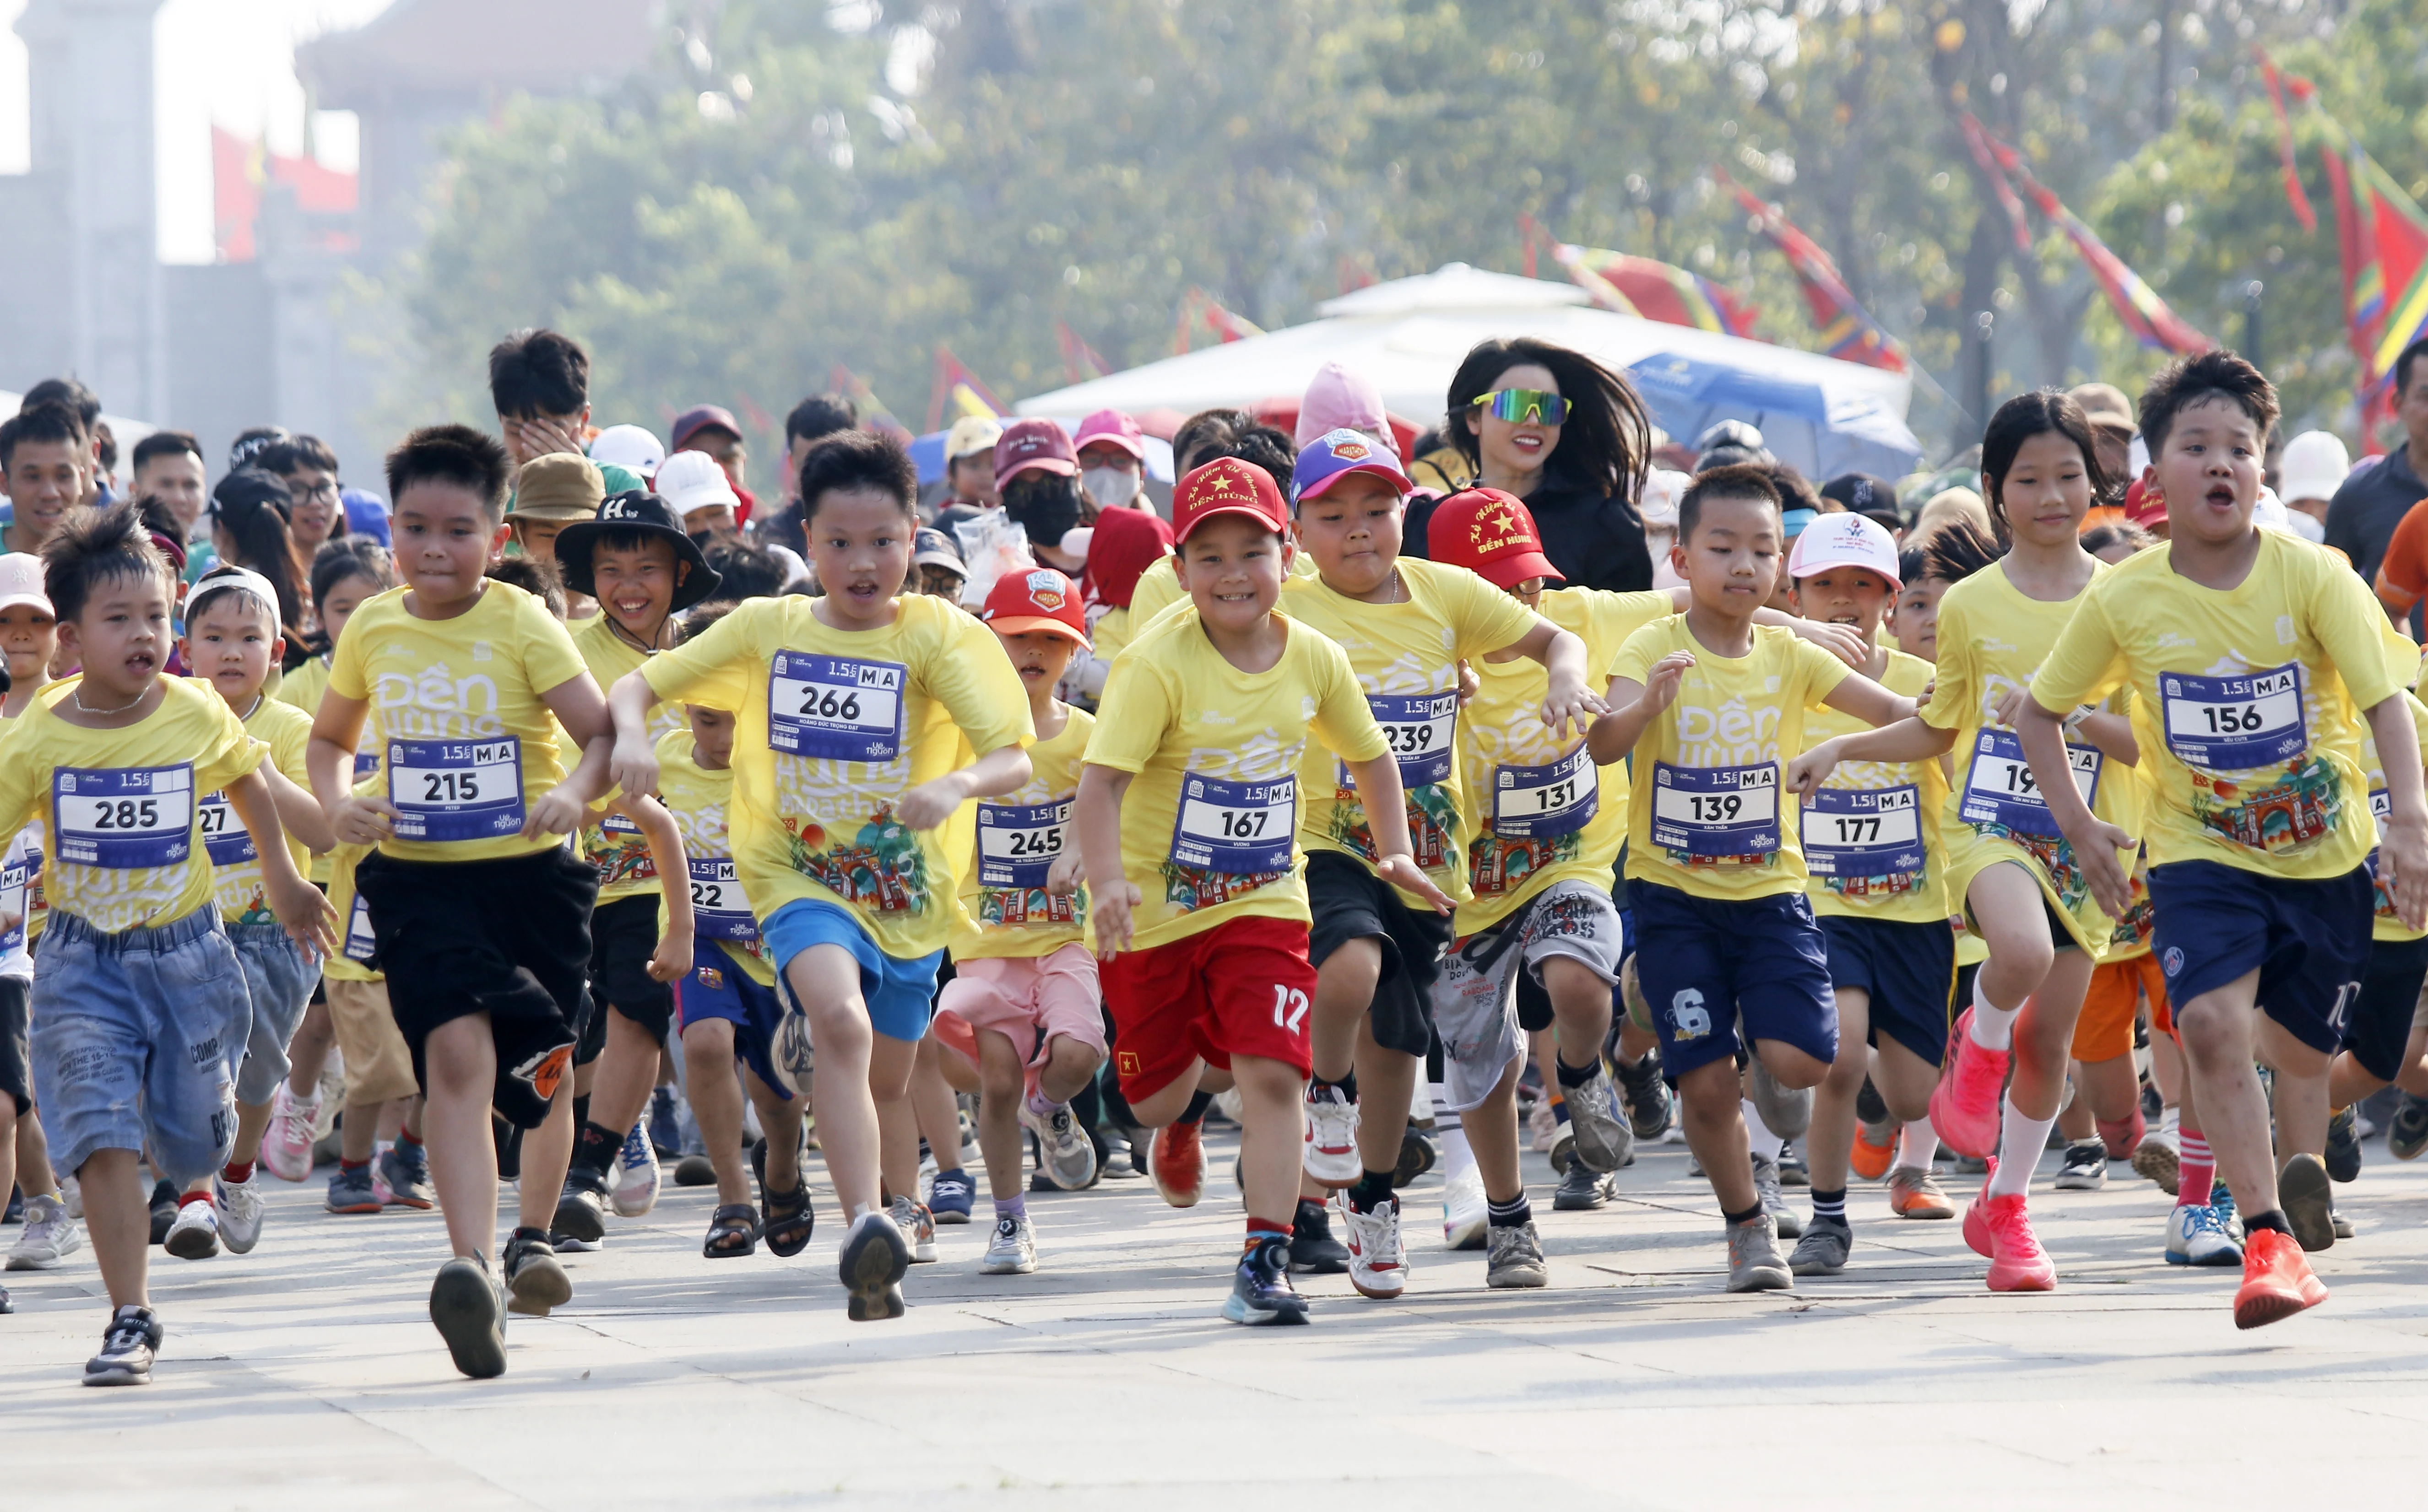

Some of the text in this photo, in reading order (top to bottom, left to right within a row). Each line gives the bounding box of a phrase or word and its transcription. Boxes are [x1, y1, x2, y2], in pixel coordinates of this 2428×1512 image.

[1339, 446, 1365, 457] MARATHON
[604, 498, 627, 520] H
[1478, 533, 1532, 554] ĐỀN HÙNG
[829, 662, 850, 677] 1.5
[862, 669, 894, 686] M A
[376, 661, 497, 712] Đền
[2222, 681, 2244, 695] 1.5
[2257, 675, 2290, 694] M A
[800, 686, 860, 720] 266
[1405, 701, 1423, 713] 1.5
[1433, 698, 1452, 715] M A
[830, 722, 847, 730] TRỌNG
[1677, 694, 1782, 743] Đền
[2203, 704, 2262, 733] 156
[1384, 724, 1432, 751] 239
[443, 745, 463, 759] 1.5
[477, 745, 510, 761] M A
[1577, 753, 1583, 766] F
[2081, 754, 2093, 767] A
[1554, 761, 1569, 777] 1.5
[121, 773, 142, 787] 1.5
[424, 772, 479, 800] 215
[1713, 772, 1730, 784] 1.5
[1743, 771, 1772, 785] M A
[2006, 765, 2040, 793] 19
[1246, 788, 1263, 800] 1.5
[1271, 787, 1291, 802] M A
[1536, 779, 1575, 810] 131
[1851, 795, 1870, 807] 1.5
[1882, 794, 1910, 808] M A
[1691, 795, 1742, 821] 139
[2375, 798, 2386, 809] A
[95, 799, 159, 828] 285
[1030, 809, 1048, 821] 1.5
[1061, 807, 1067, 818] F
[1222, 811, 1268, 837] 167
[1836, 817, 1881, 842] 177
[1010, 828, 1062, 855] 245
[691, 863, 710, 874] 1.5
[721, 865, 733, 877] M
[4, 870, 22, 886] M A
[691, 883, 722, 907] 22
[1274, 983, 1309, 1037] 12
[1672, 987, 1711, 1036] 6
